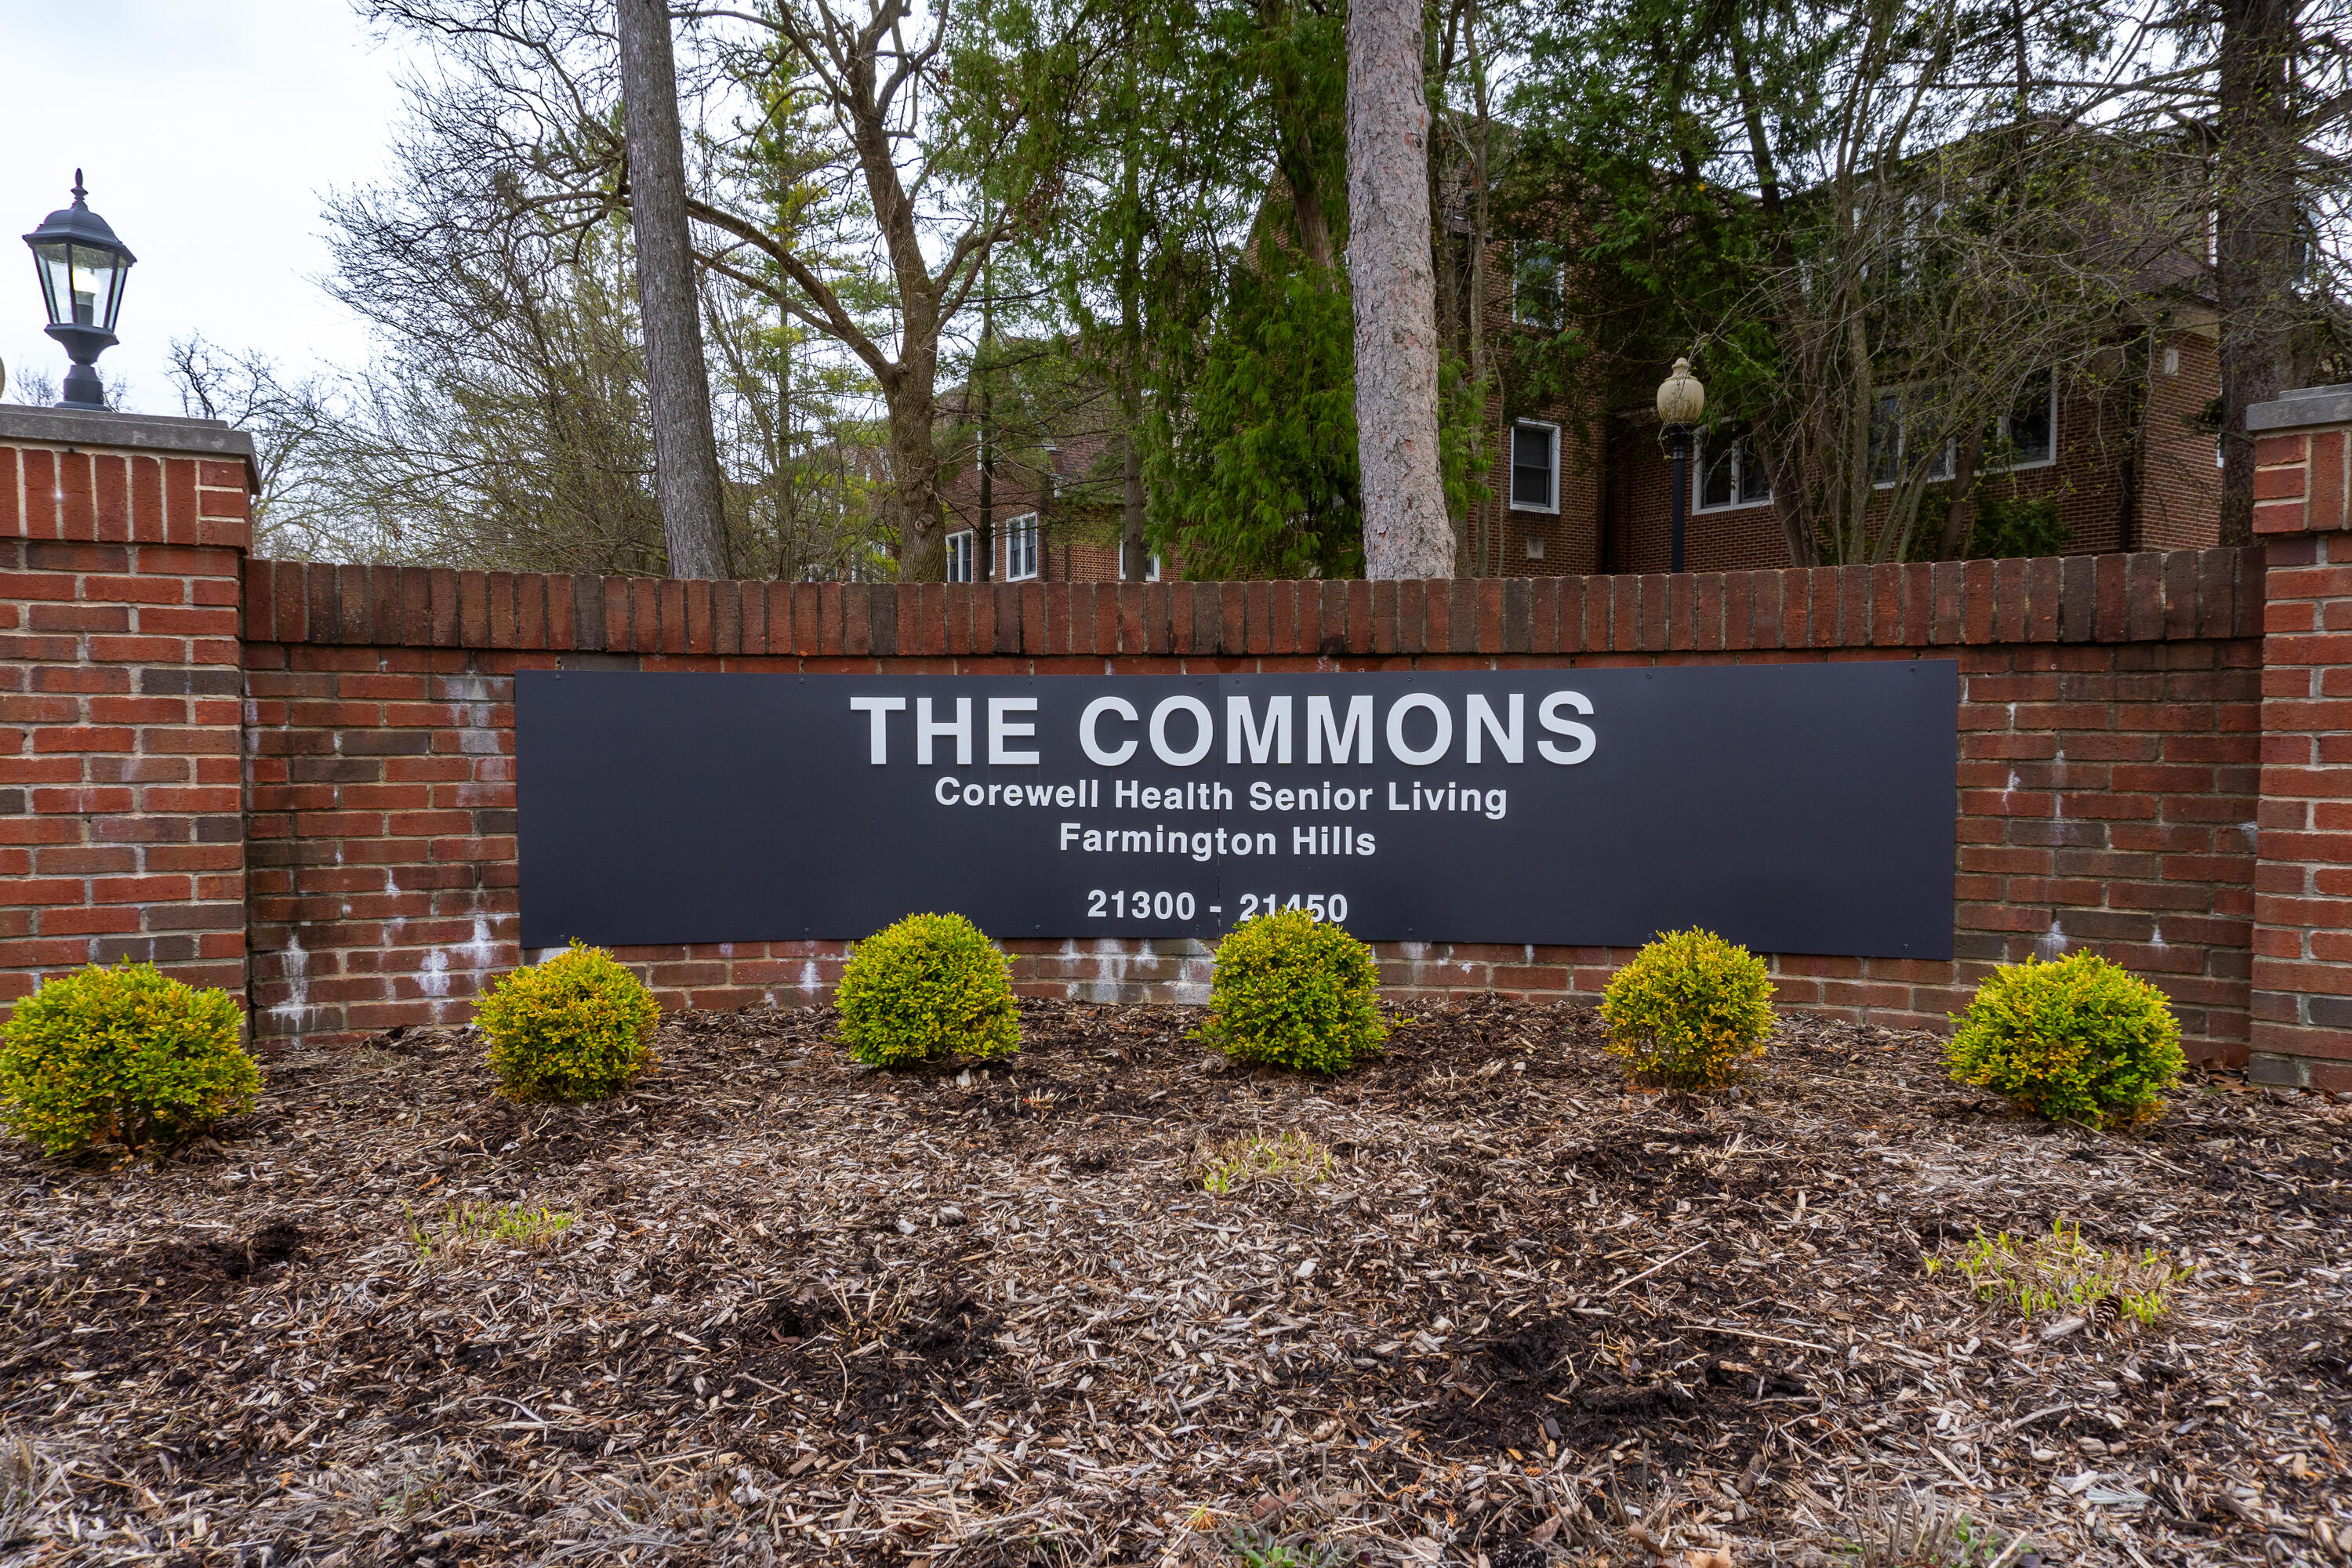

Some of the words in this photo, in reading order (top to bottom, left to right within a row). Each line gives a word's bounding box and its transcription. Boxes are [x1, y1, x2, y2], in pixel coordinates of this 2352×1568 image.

[849, 695, 1040, 766] THE
[1078, 689, 1598, 768] COMMONS
[934, 775, 1099, 808] Corewell
[1114, 779, 1233, 811] Health
[1248, 780, 1374, 812] Senior
[1388, 780, 1508, 821] Living
[1059, 822, 1277, 862] Farmington
[1292, 825, 1377, 856] Hills
[1087, 888, 1196, 920] 21300
